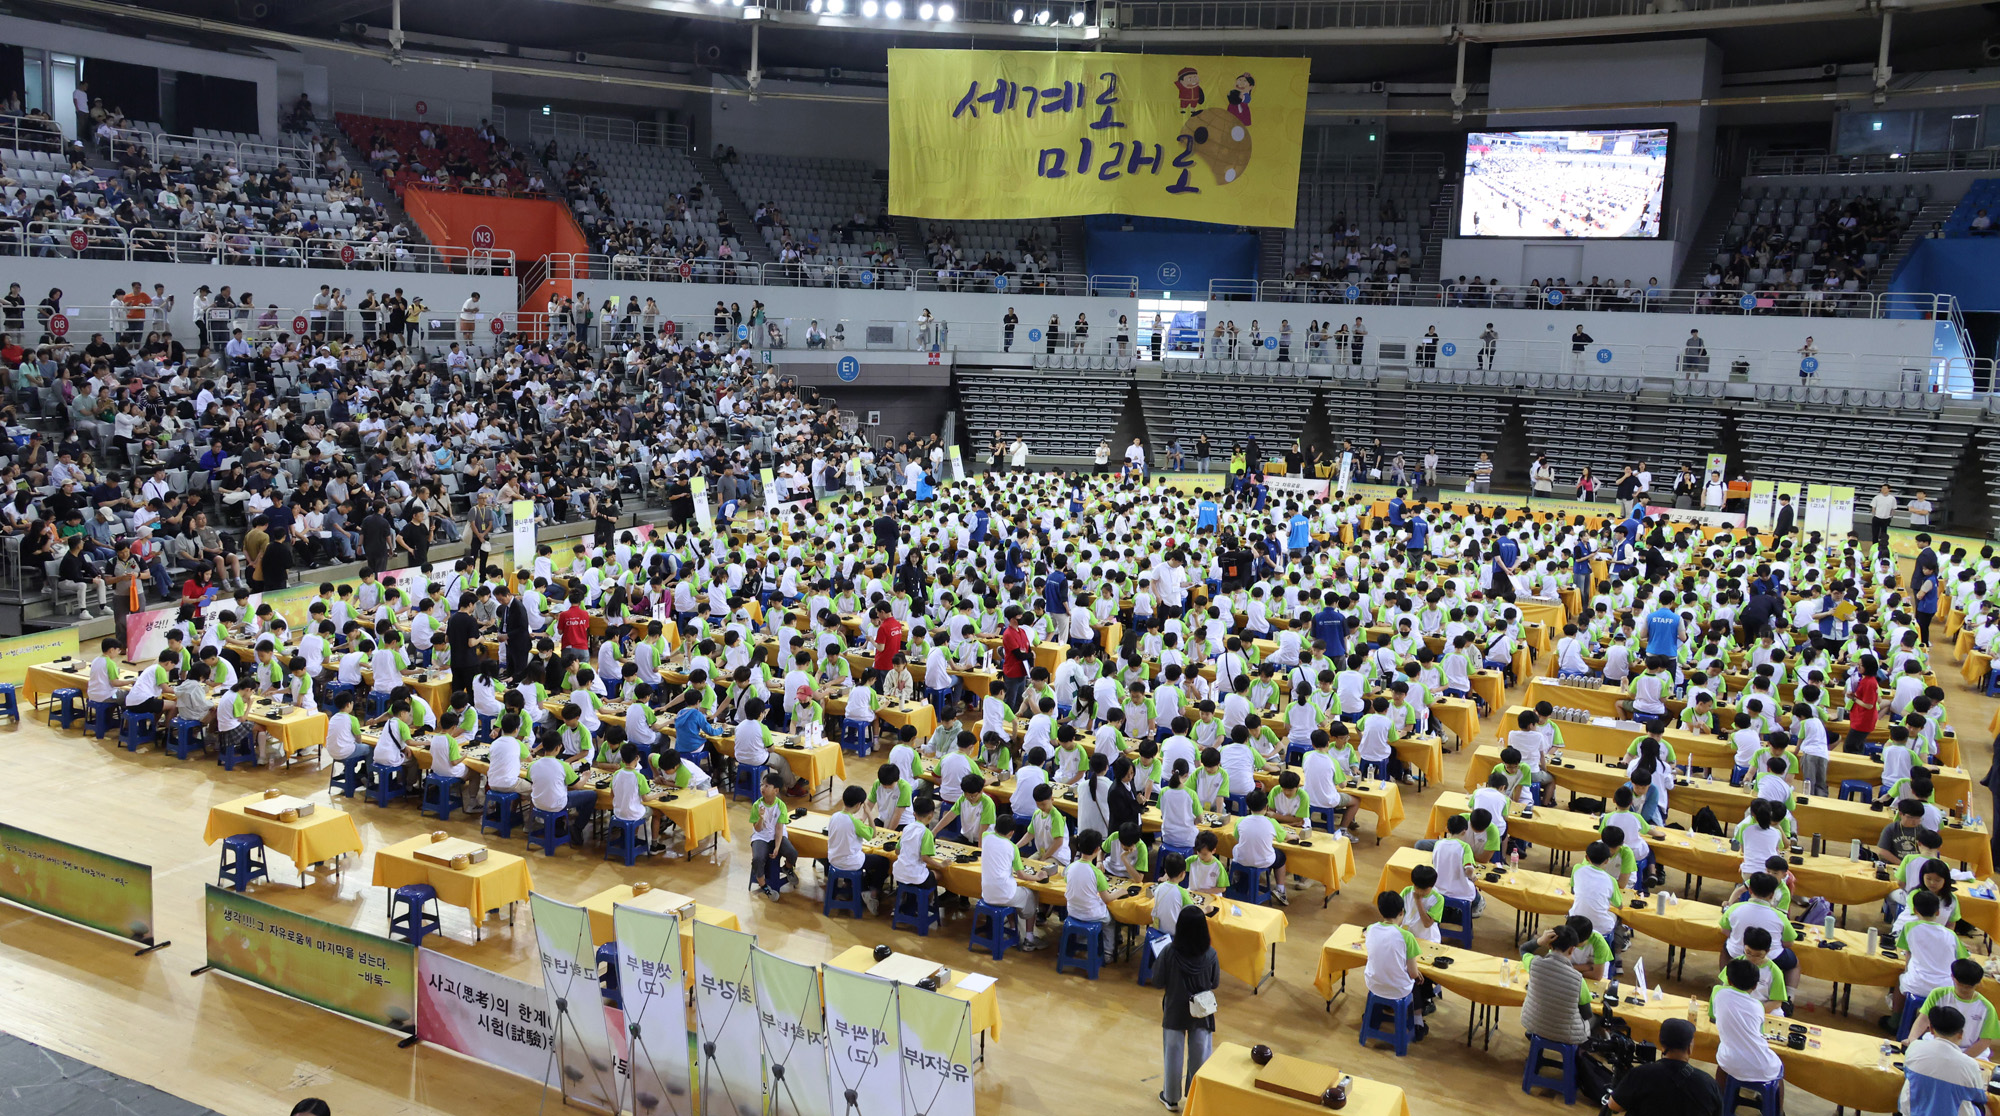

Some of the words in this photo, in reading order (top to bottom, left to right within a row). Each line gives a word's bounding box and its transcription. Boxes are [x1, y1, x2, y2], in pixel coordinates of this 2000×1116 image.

[953, 72, 1125, 130] 세계로
[1038, 134, 1200, 194] 미래로
[74, 236, 84, 244] 36
[476, 232, 491, 244] N3
[344, 250, 352, 258] 37
[1163, 268, 1176, 277] E2
[54, 320, 65, 329] 08
[842, 362, 854, 372] E1
[146, 619, 168, 632] 생각!!
[269, 925, 312, 948] 자유로움에
[317, 940, 354, 960] 마지막을
[358, 951, 391, 971] 넘는다.
[358, 972, 391, 987] -바둑-
[429, 974, 509, 1017] 사고(思考)의
[518, 1003, 552, 1030] 한계(
